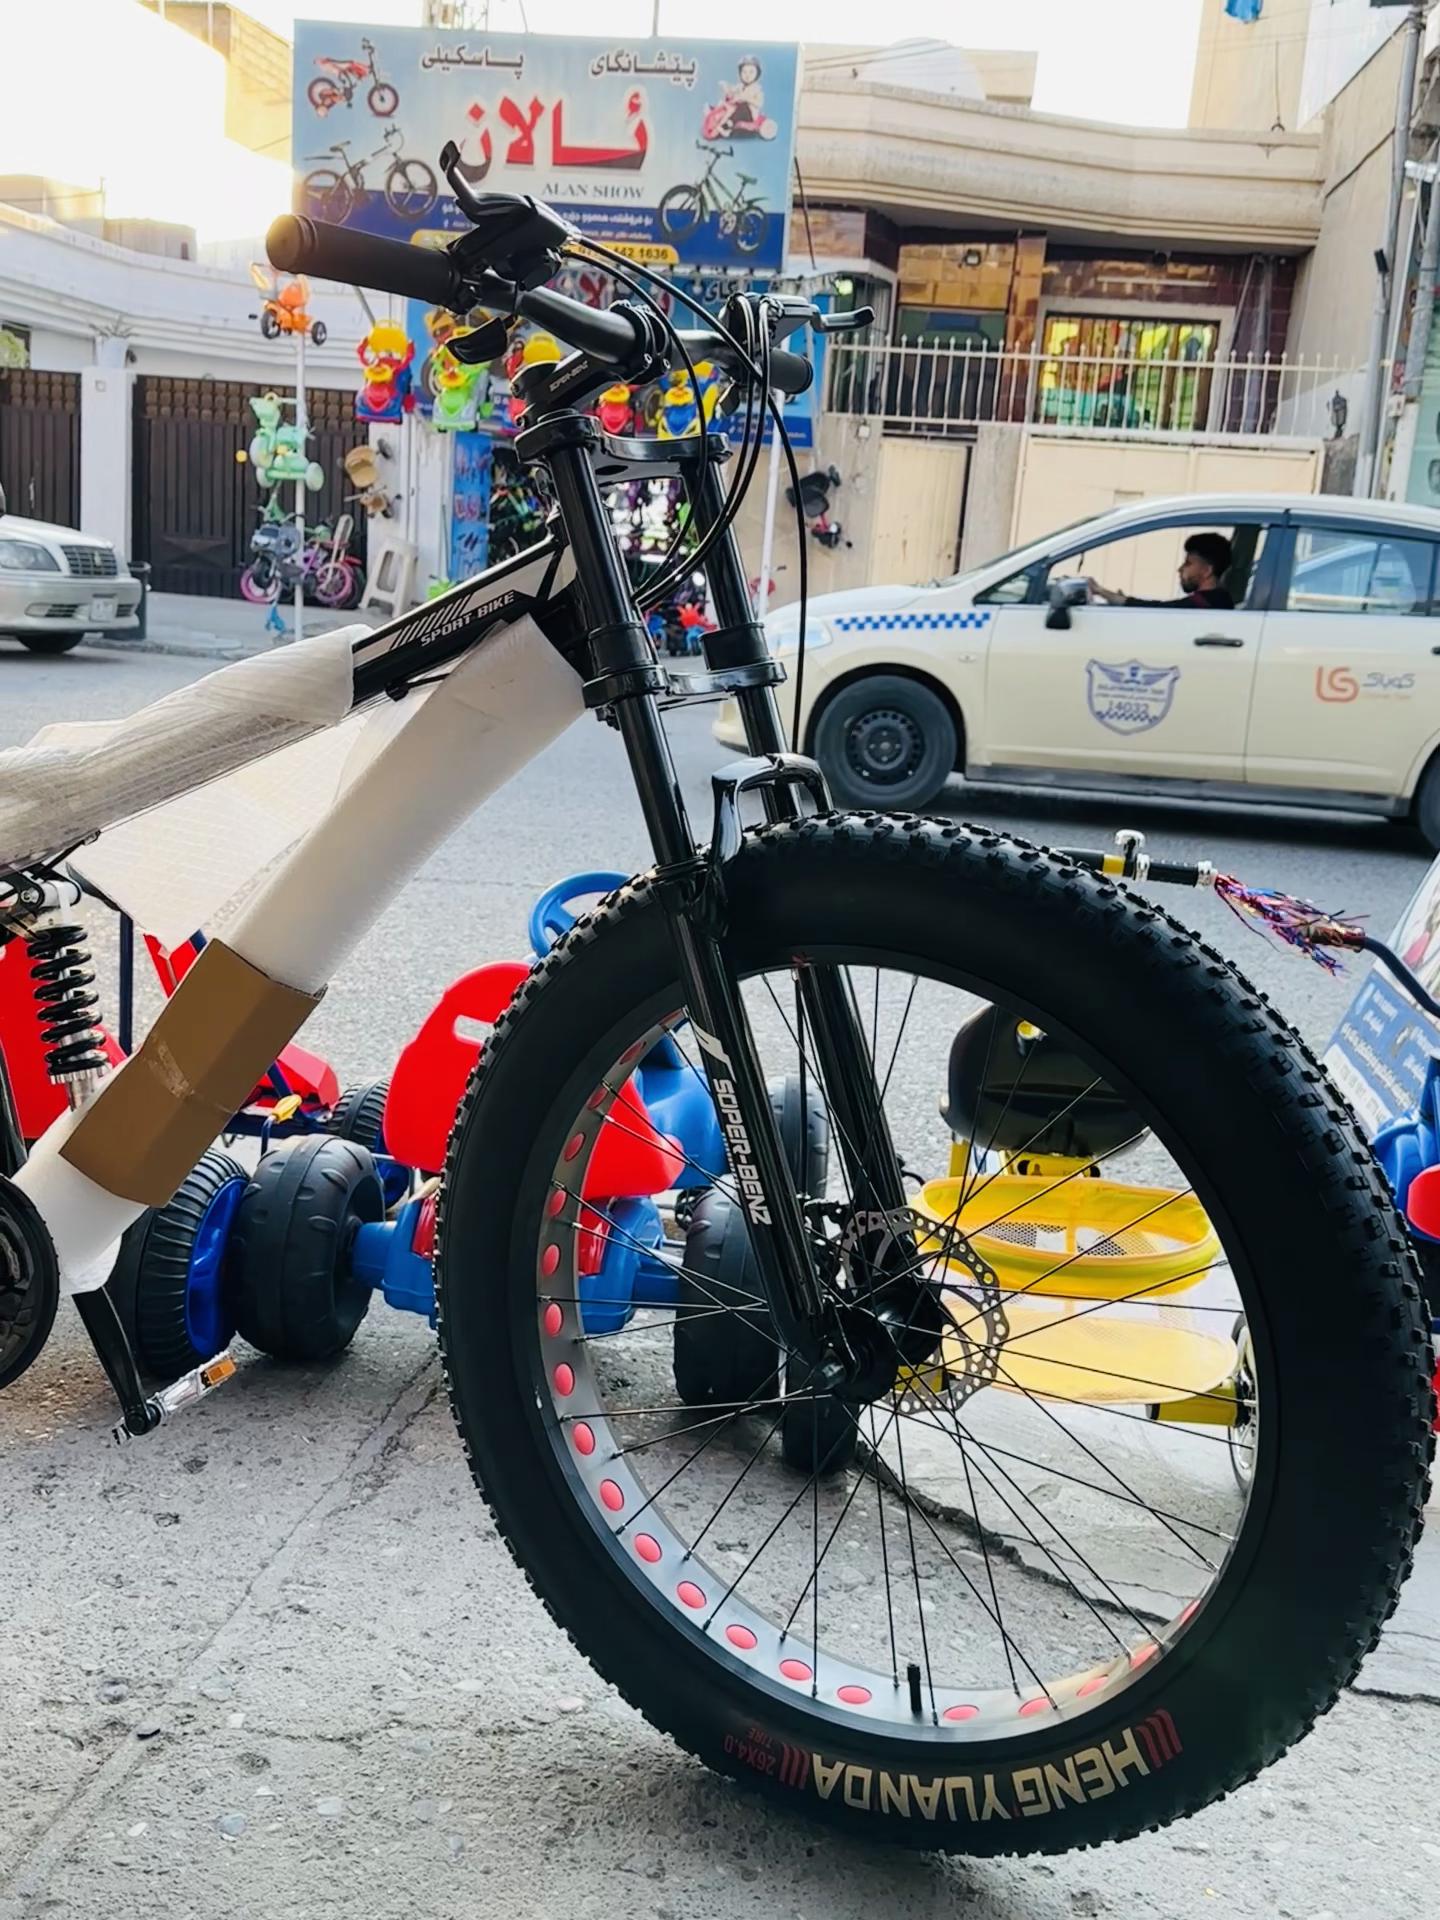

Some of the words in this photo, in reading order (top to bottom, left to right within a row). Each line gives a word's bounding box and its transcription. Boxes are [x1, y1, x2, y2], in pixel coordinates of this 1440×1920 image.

[421, 44, 525, 80] پاسکیلی
[454, 91, 649, 184] ئالان
[542, 182, 589, 197] ALAN
[593, 184, 644, 199] SHOW
[420, 611, 474, 647] SPORT
[477, 591, 515, 619] BIKE
[1011, 1727, 1151, 1817] HENG
